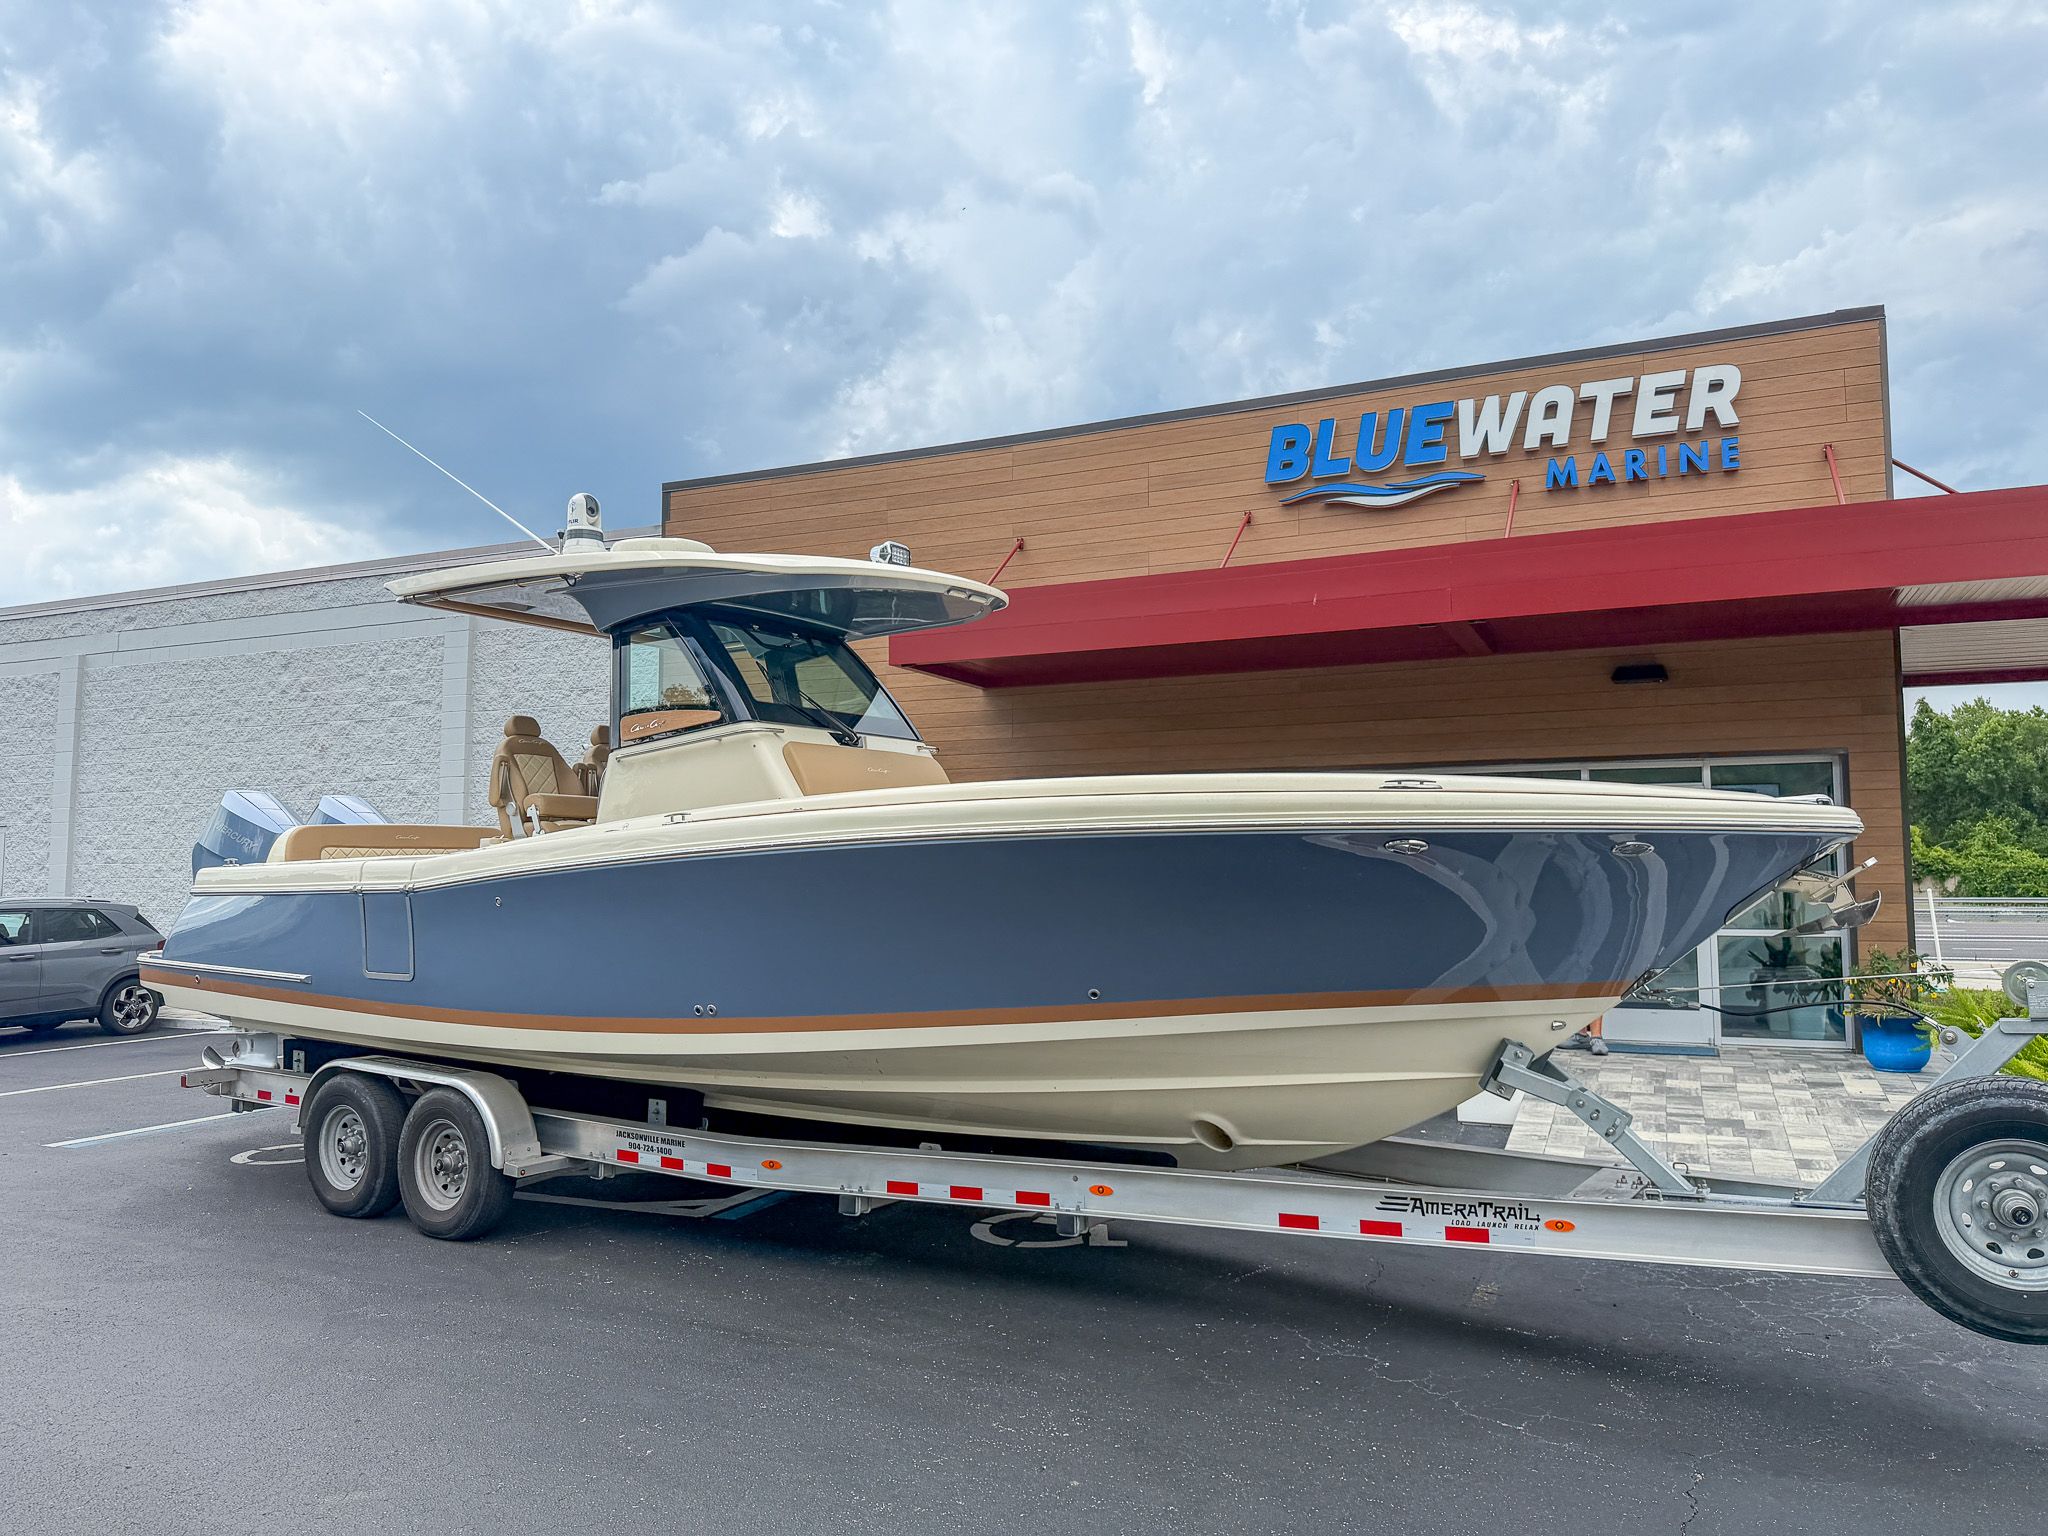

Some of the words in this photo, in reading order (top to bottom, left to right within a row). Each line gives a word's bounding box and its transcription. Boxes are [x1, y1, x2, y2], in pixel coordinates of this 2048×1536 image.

[1264, 363, 1742, 484] BLUEWATER
[1545, 437, 1742, 491] MARINE
[616, 1130, 660, 1144] JACKSONVILLE
[660, 1137, 686, 1148] MARINE
[628, 1141, 673, 1156] 904-724-1400
[1451, 1219, 1471, 1227] LOAD
[1477, 1220, 1508, 1229] LAUNCH
[1514, 1223, 1540, 1231] RELAX
